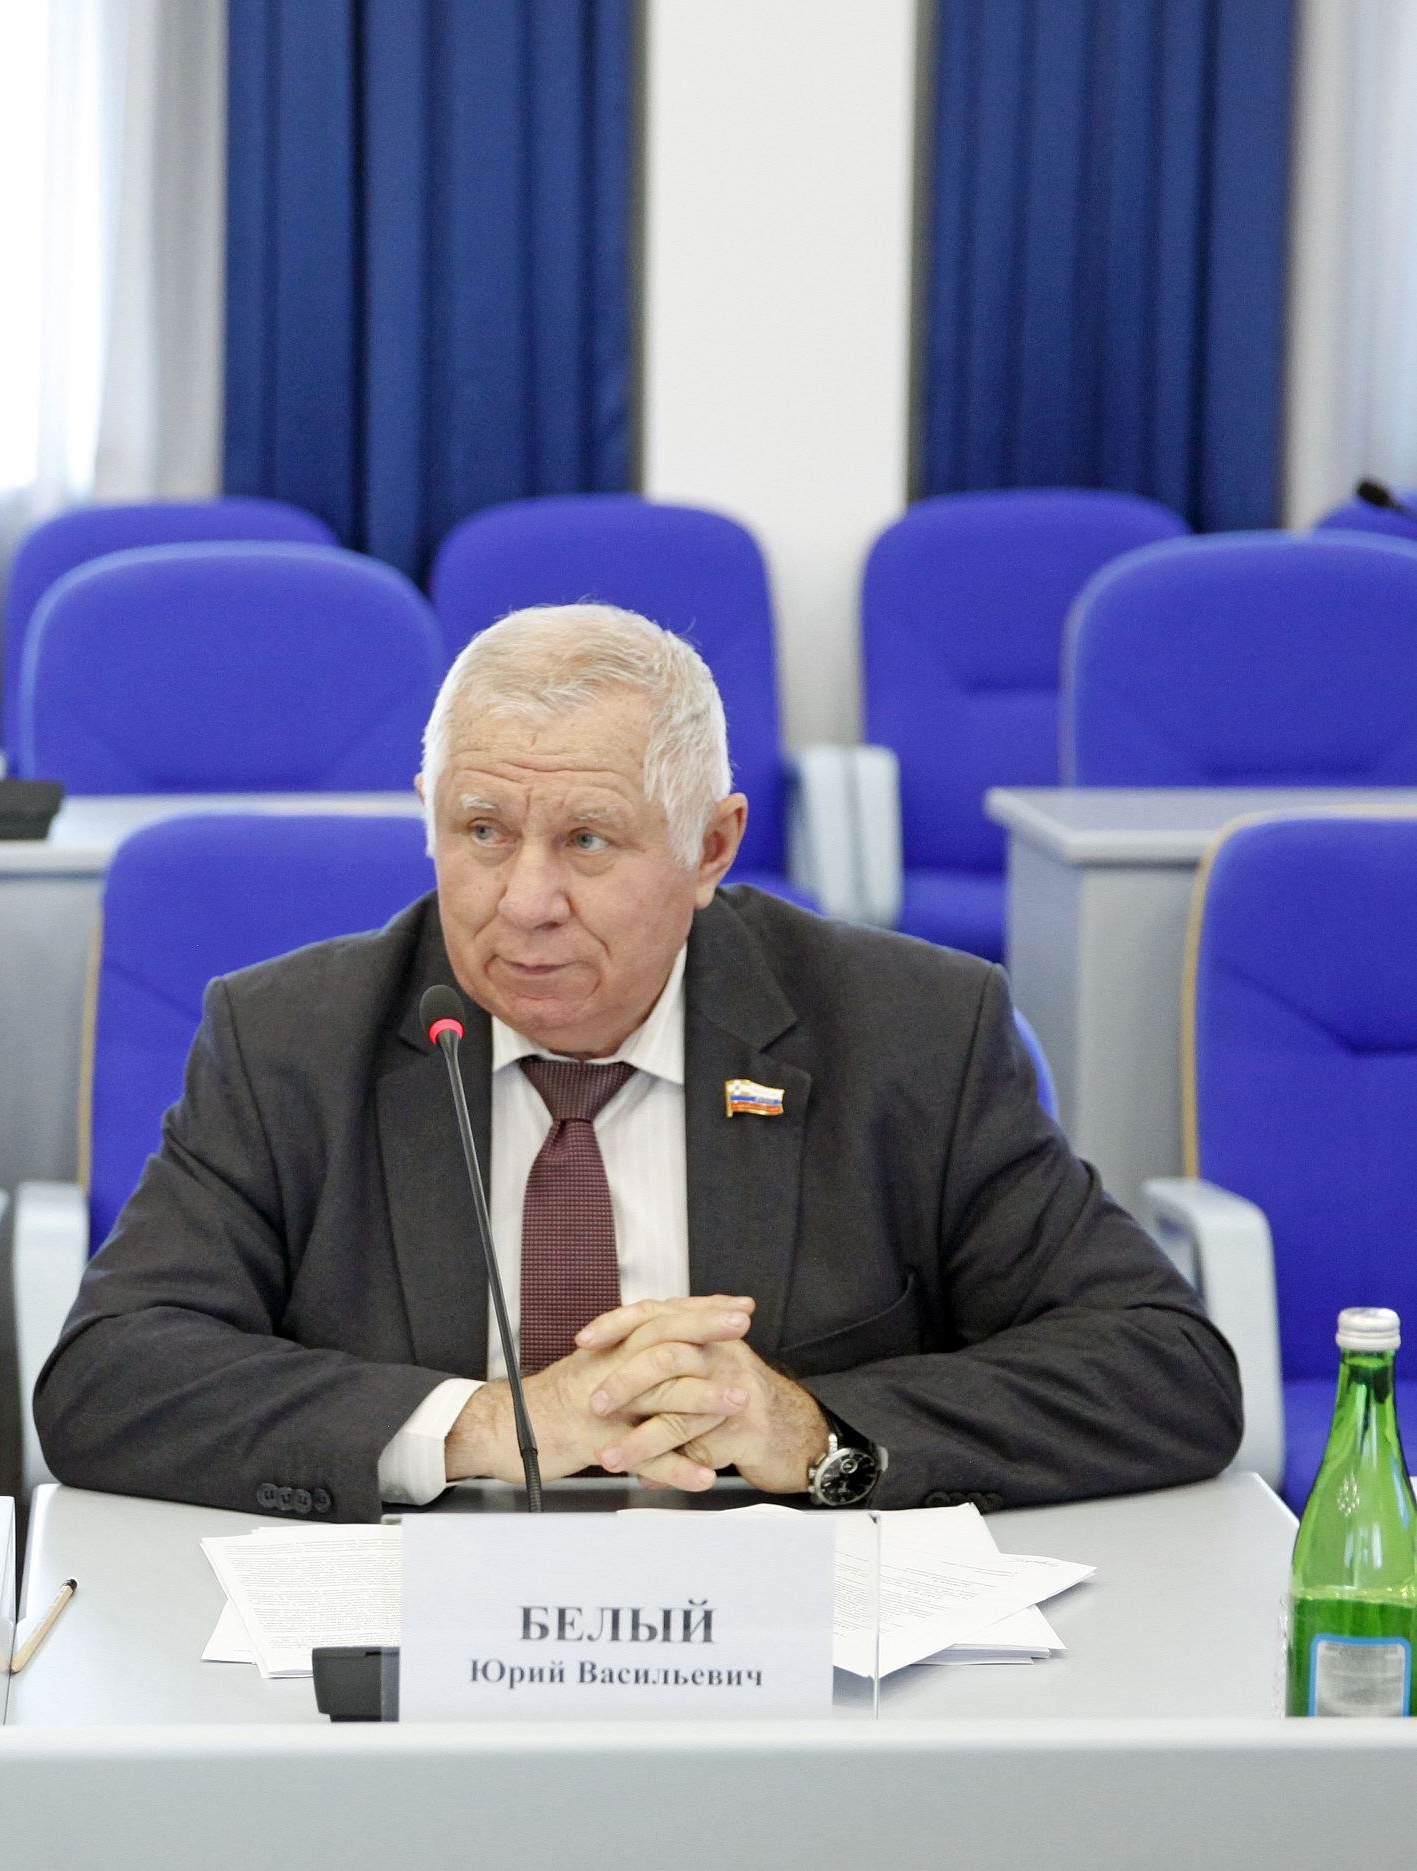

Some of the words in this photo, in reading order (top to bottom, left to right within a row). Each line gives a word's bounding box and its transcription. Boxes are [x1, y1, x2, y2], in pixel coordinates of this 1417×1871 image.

[519, 1599, 715, 1644] БЕЛЫЙ
[470, 1659, 565, 1690] Юрий
[577, 1660, 763, 1687] Васильевич
